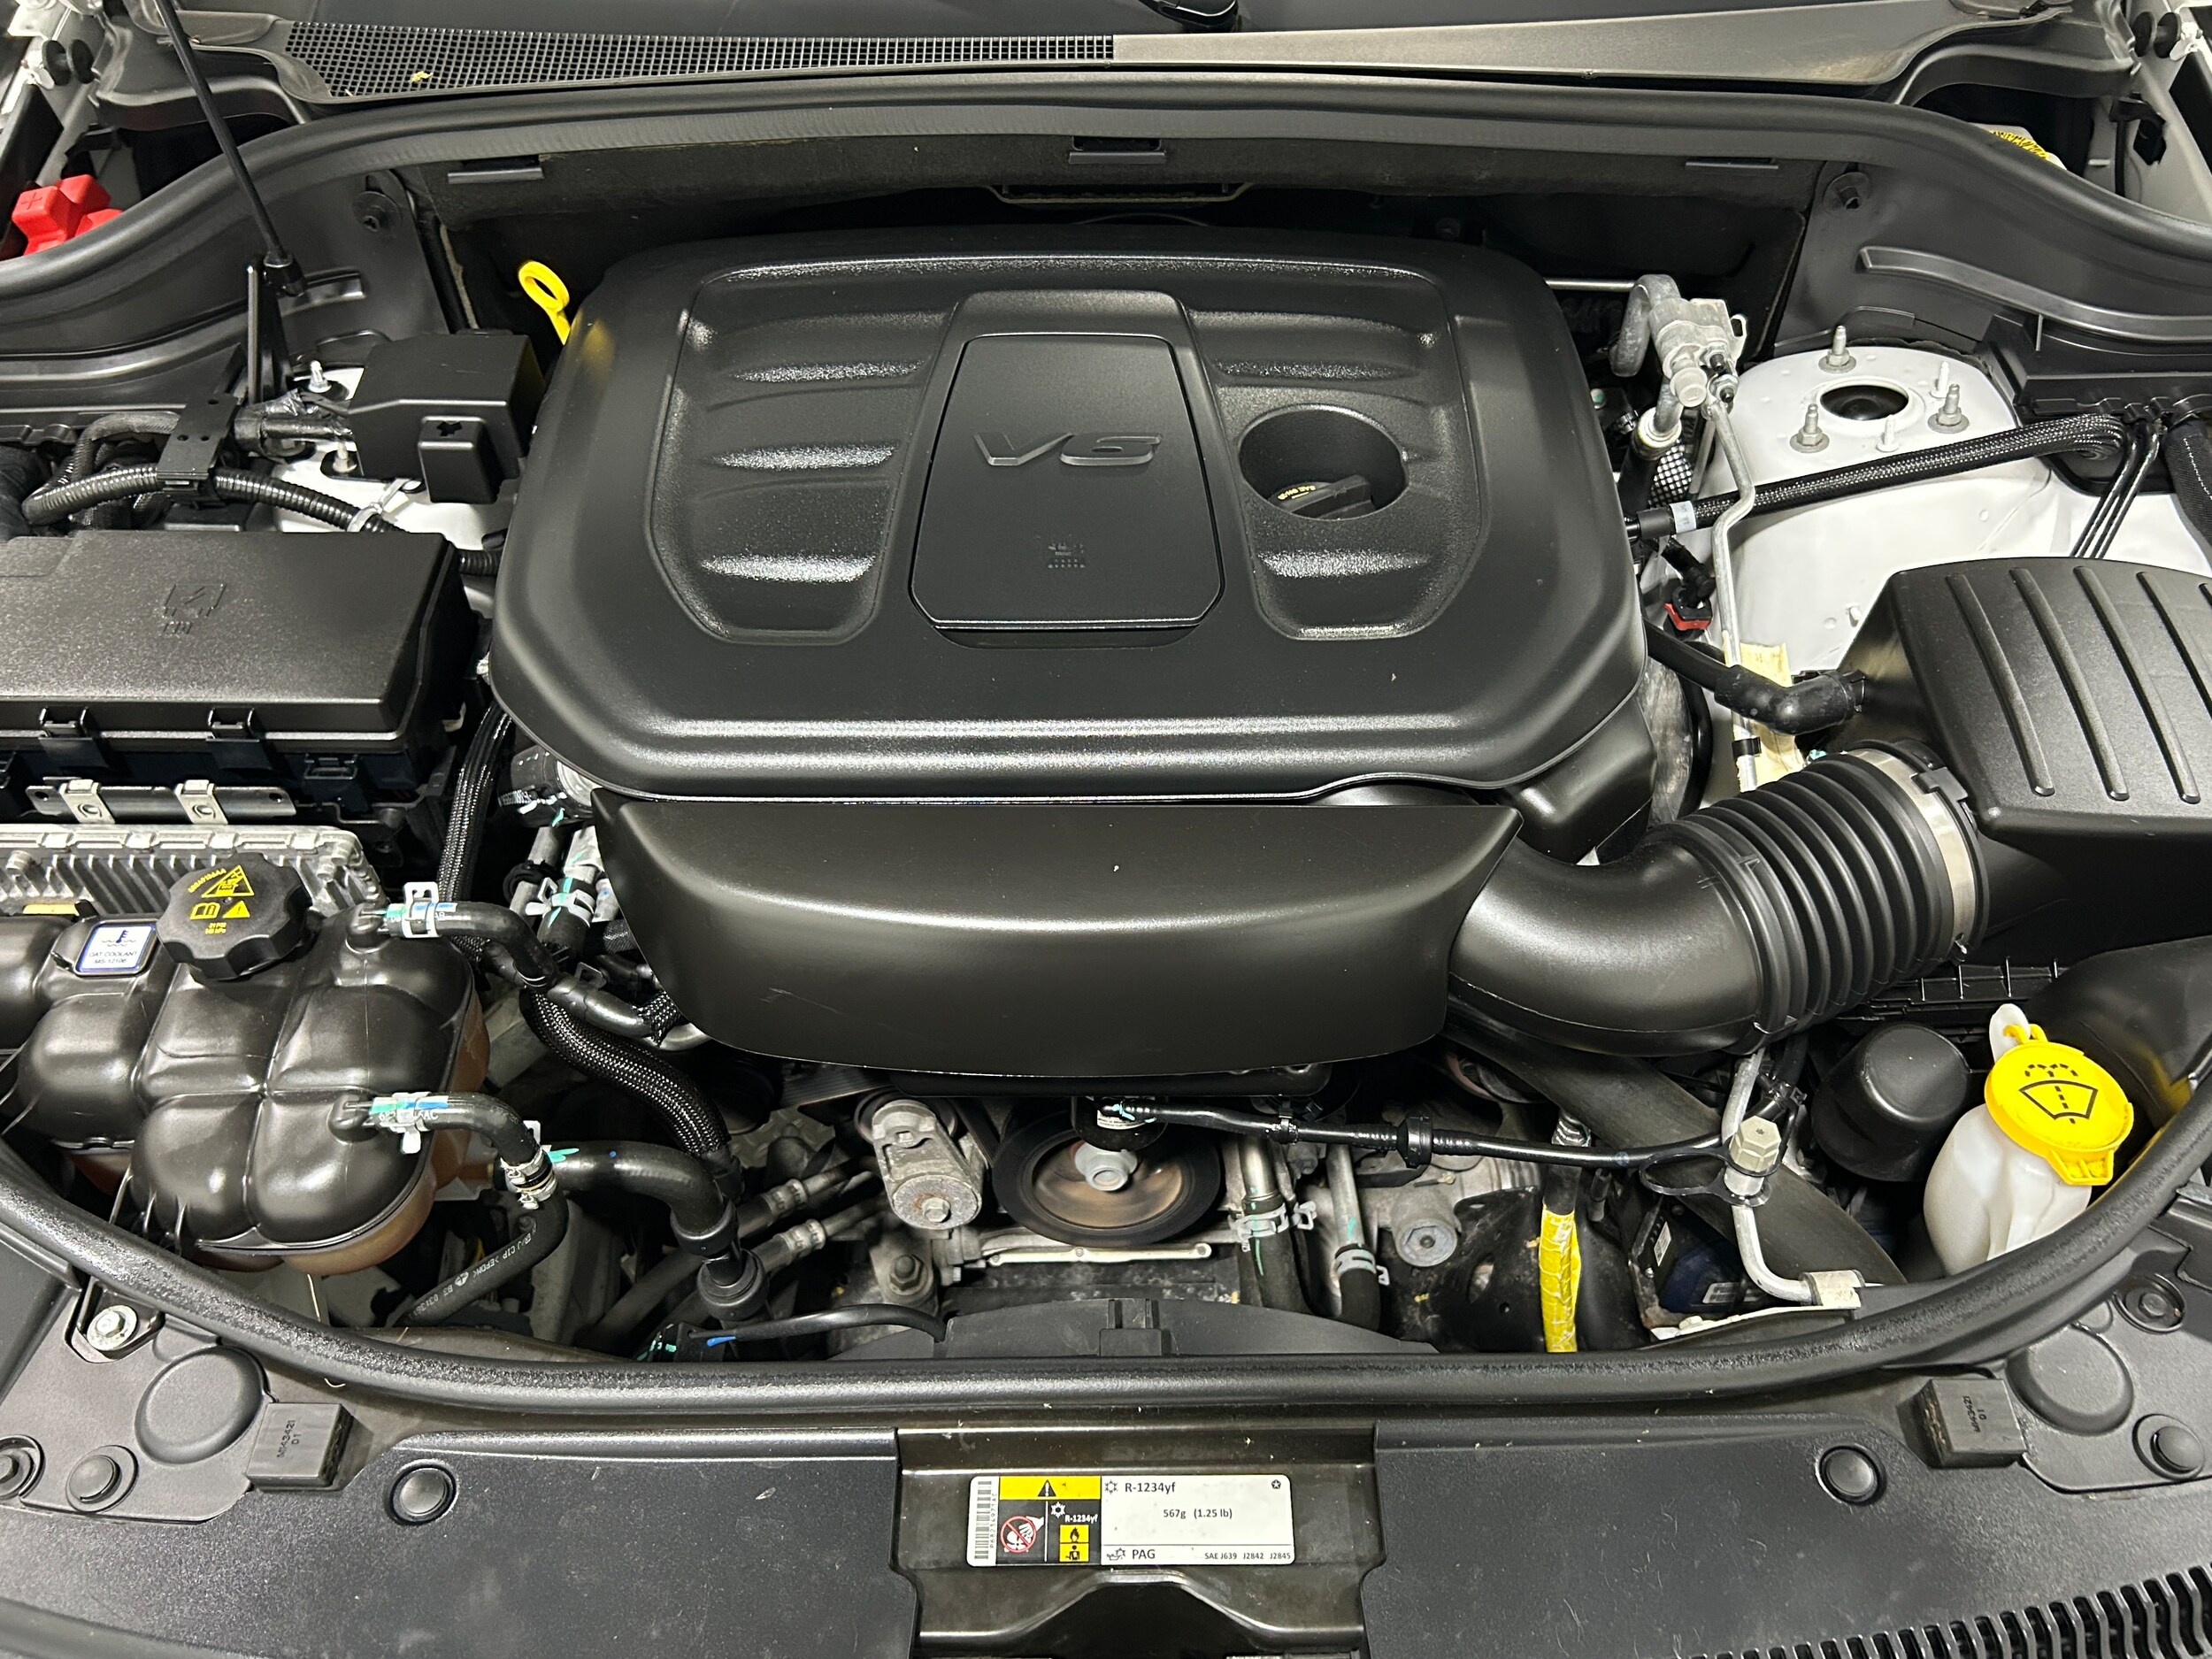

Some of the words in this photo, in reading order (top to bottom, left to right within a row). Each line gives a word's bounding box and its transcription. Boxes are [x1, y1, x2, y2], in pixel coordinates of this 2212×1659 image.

[972, 432, 1163, 466] V6
[1125, 1481, 1176, 1495] R-1234yf
[1064, 1514, 1099, 1525] R-1234yf
[1163, 1508, 1187, 1520] 567g
[1194, 1508, 1217, 1520] (1.25
[1220, 1508, 1233, 1520] lb)
[1132, 1548, 1156, 1560] PAG
